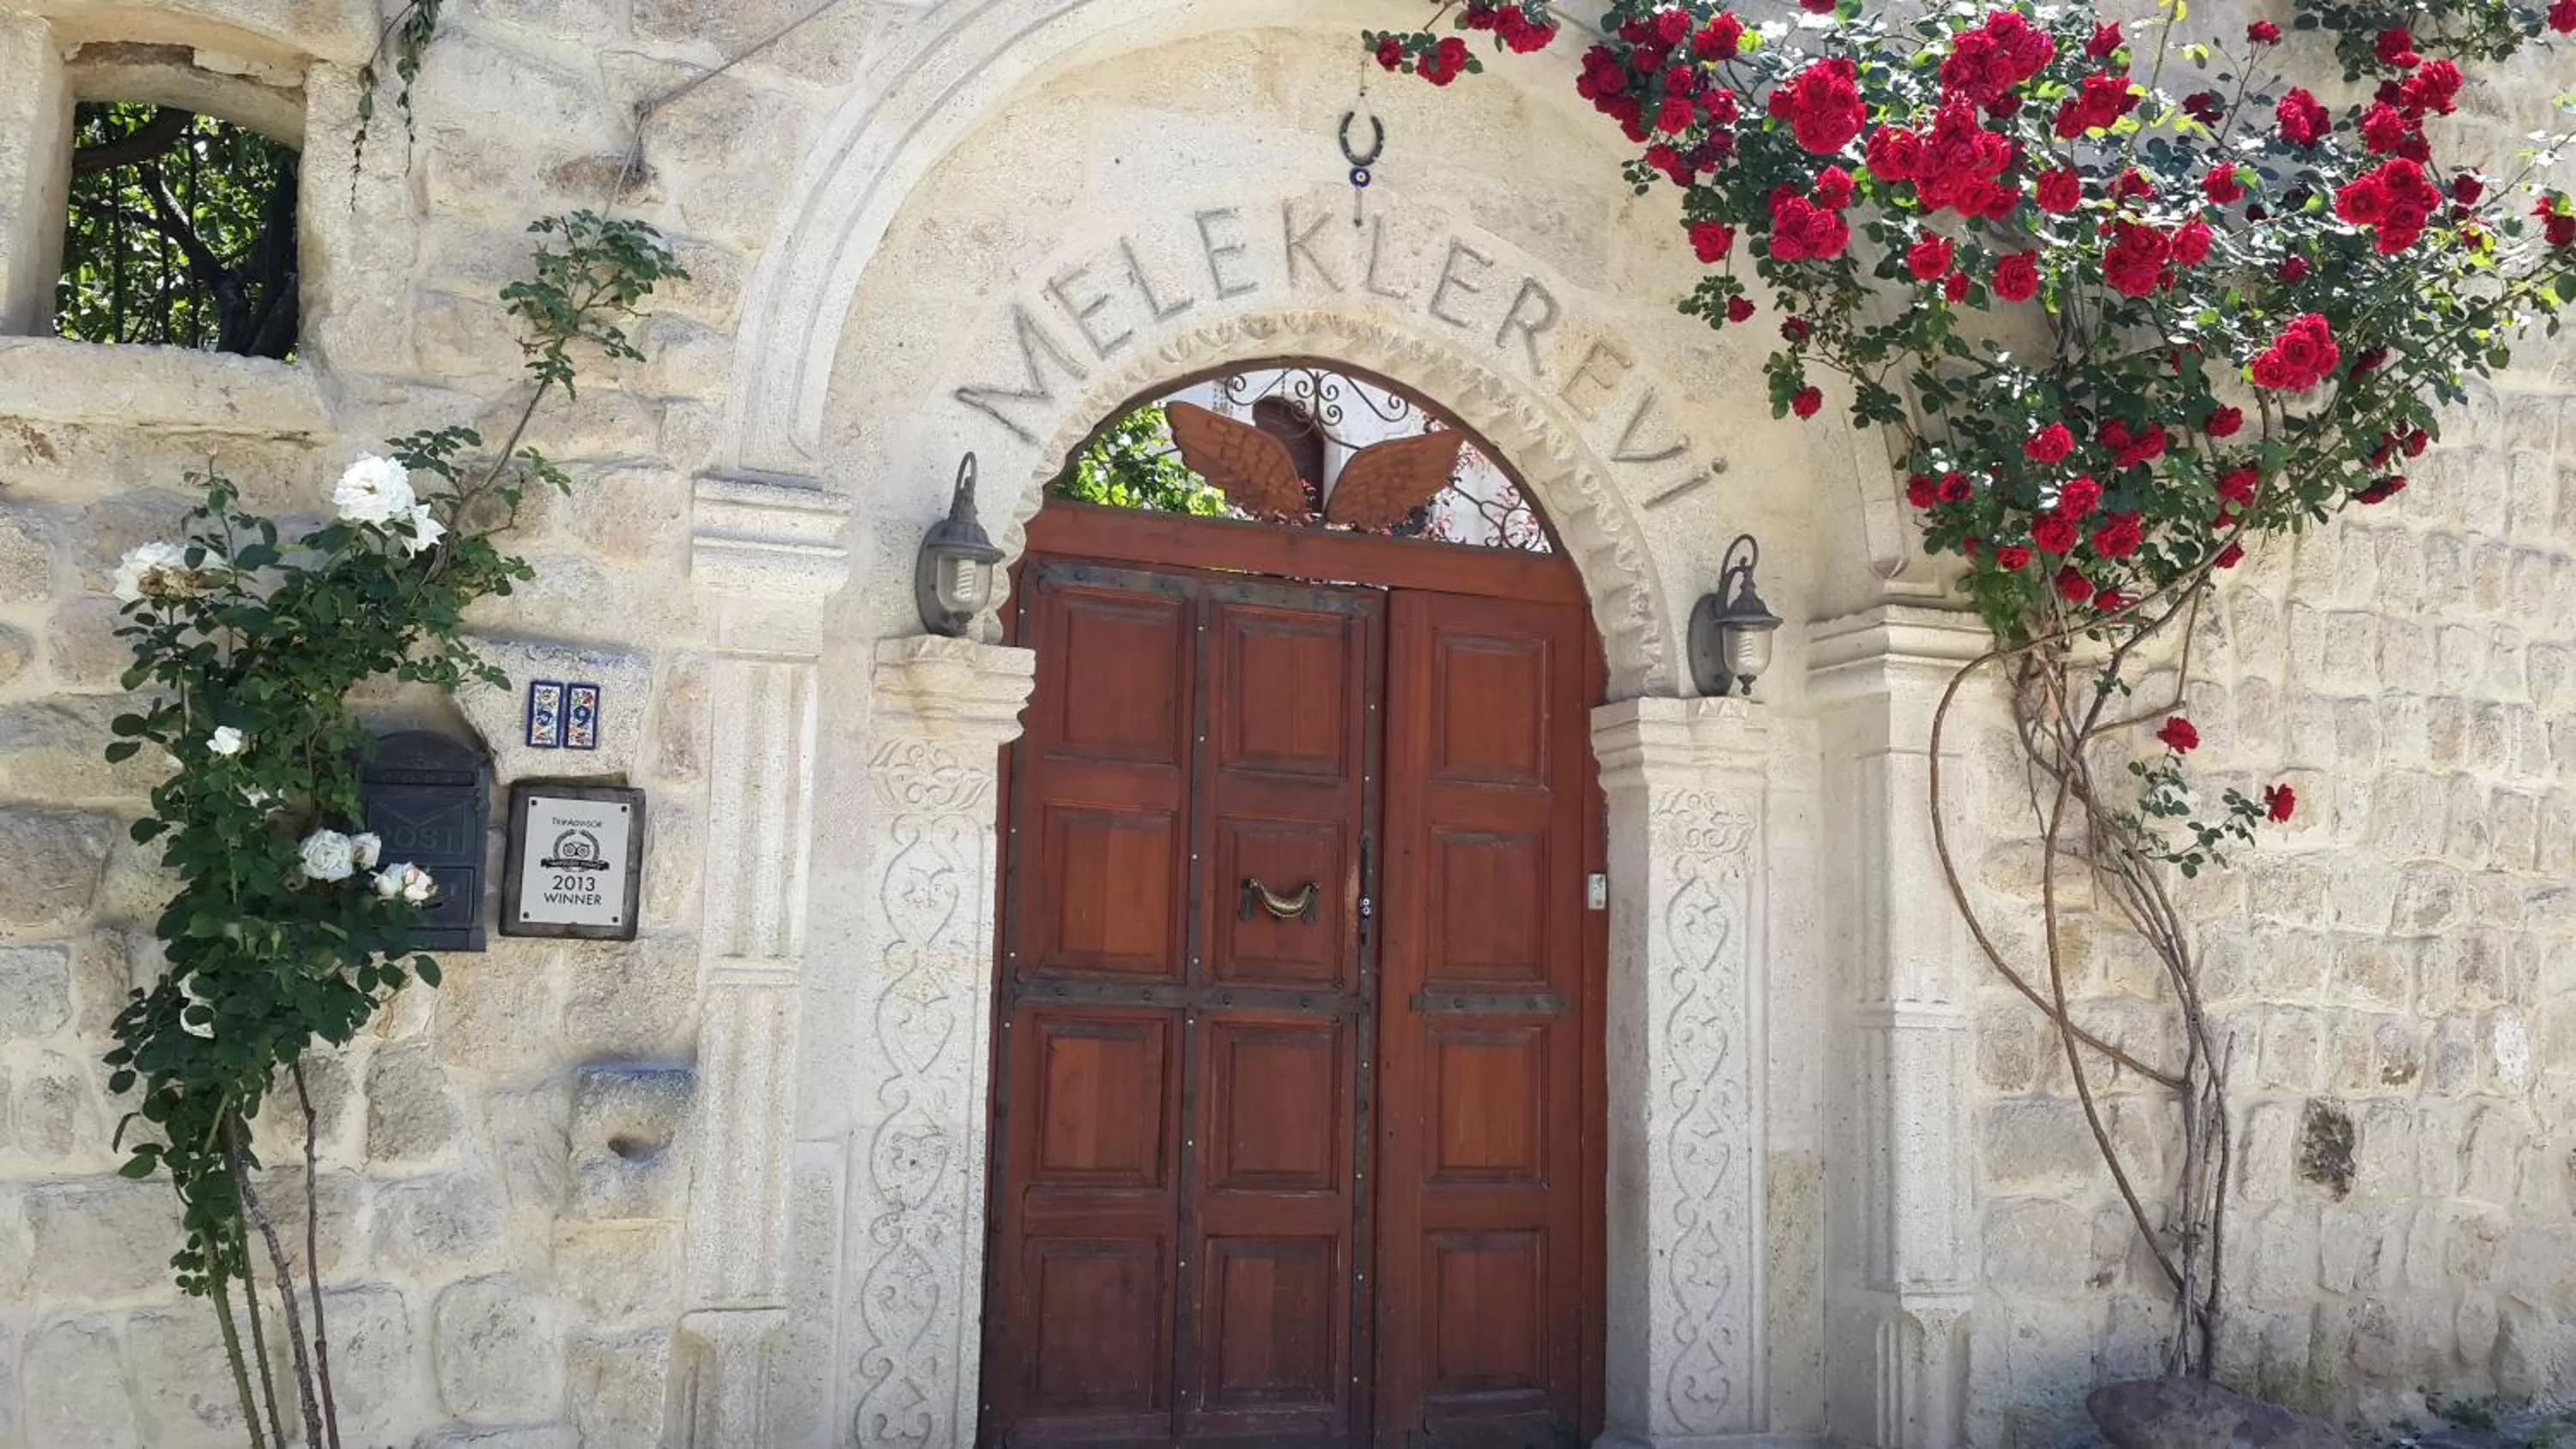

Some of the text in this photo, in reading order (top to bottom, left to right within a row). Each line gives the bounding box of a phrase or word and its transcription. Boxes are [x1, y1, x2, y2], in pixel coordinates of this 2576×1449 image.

[954, 197, 1560, 445] MELEKLER
[552, 875, 596, 892] 2013
[544, 892, 602, 906] WINNER
